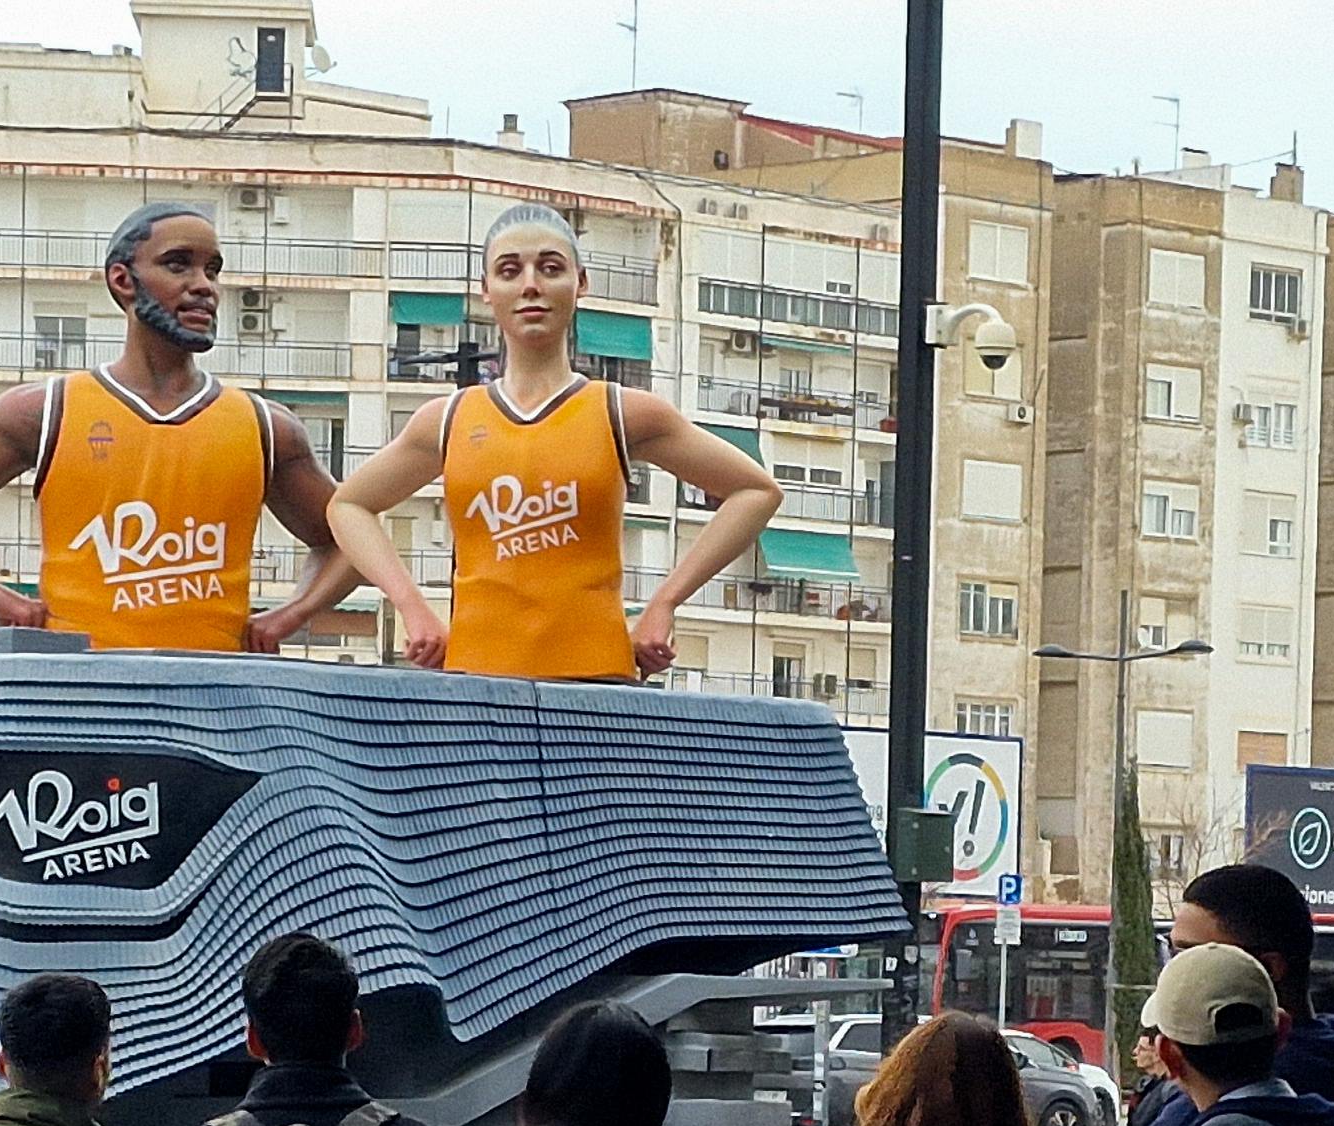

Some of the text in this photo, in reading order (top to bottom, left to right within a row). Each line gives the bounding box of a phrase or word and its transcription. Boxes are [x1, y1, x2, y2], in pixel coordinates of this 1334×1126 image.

[496, 524, 580, 561] ARENA
[111, 573, 224, 612] ARENA
[42, 841, 151, 880] ARENA
